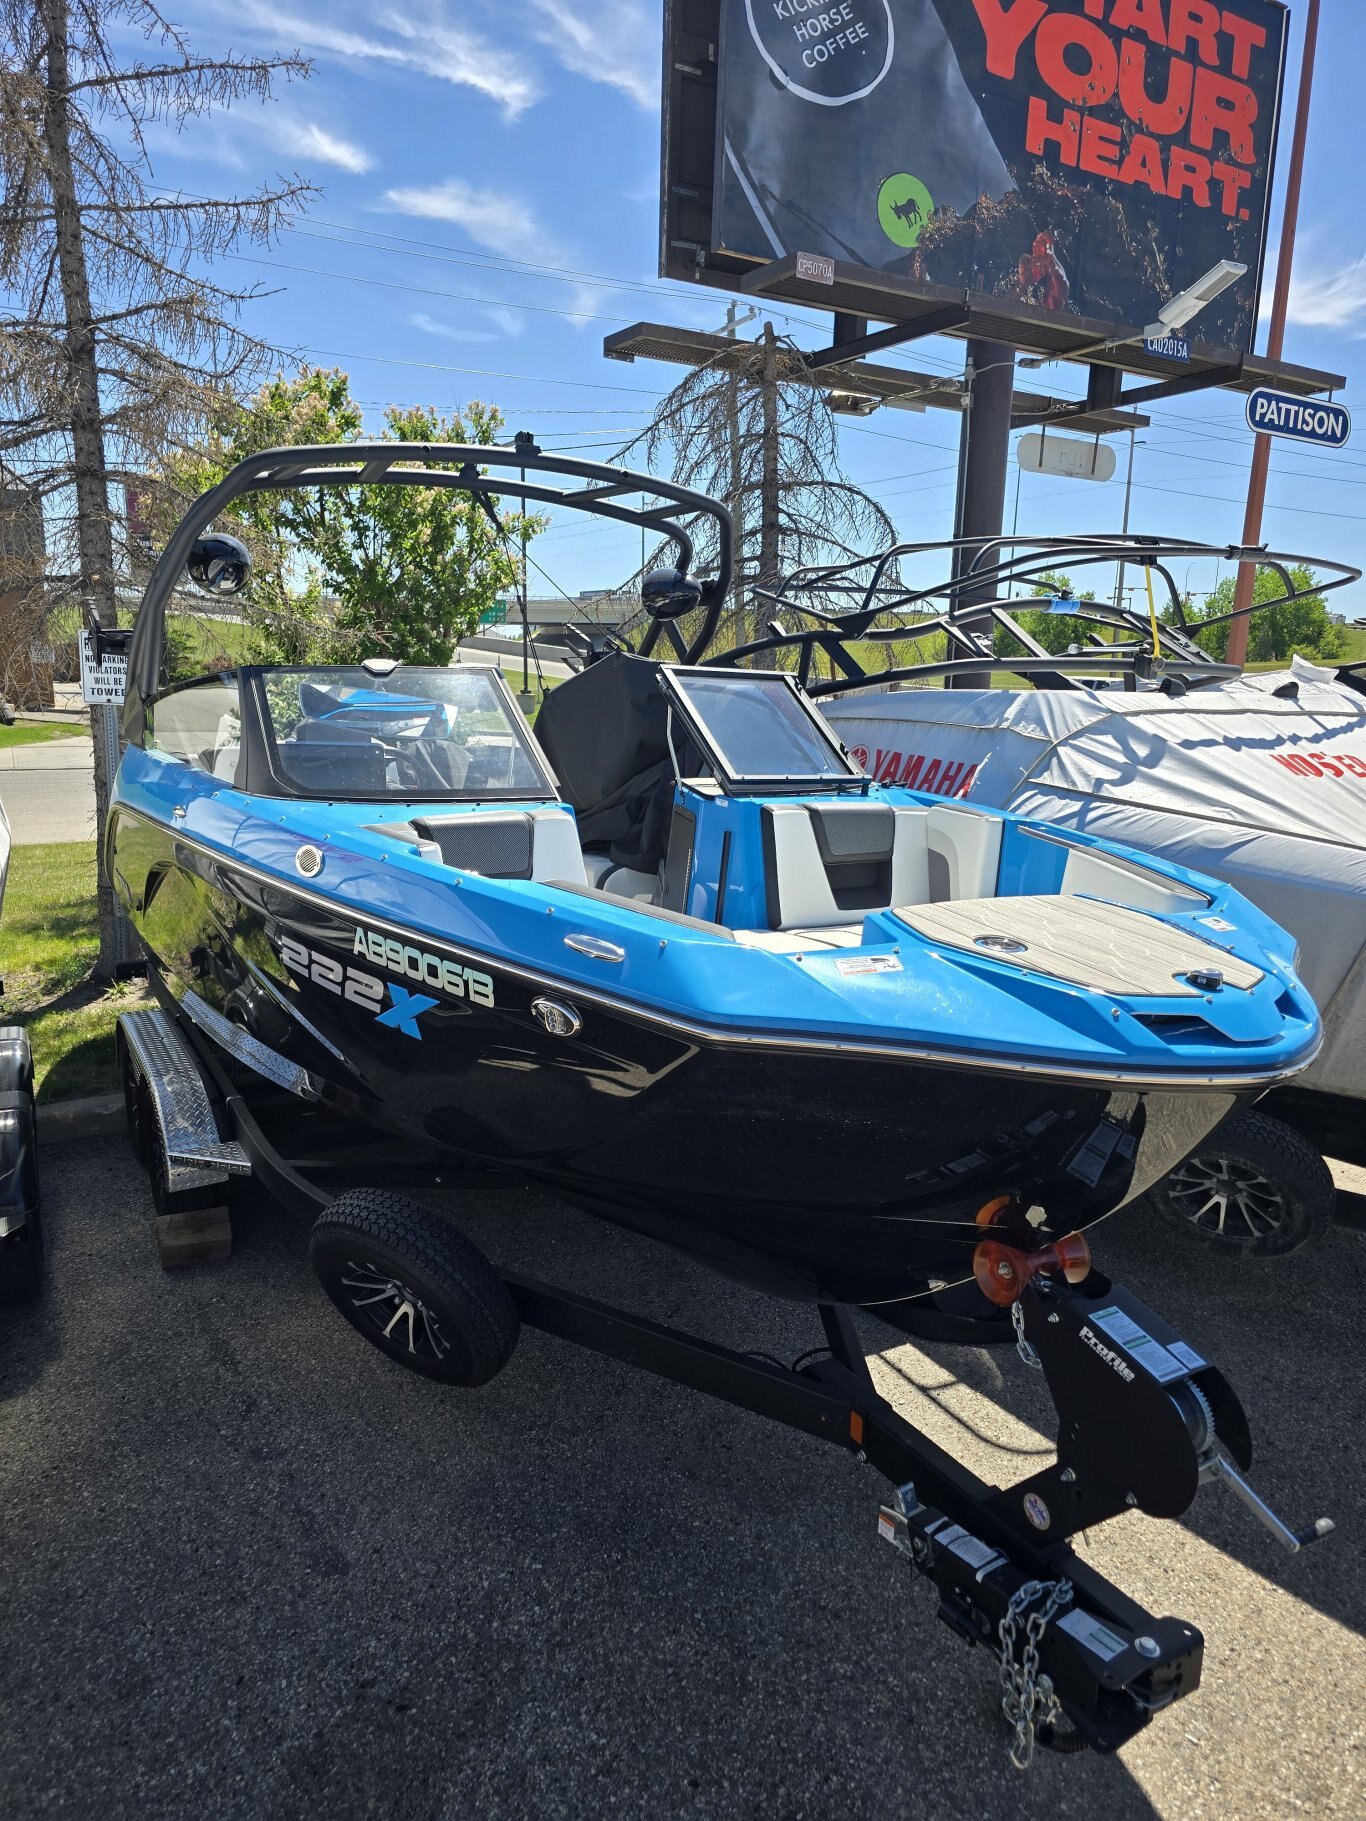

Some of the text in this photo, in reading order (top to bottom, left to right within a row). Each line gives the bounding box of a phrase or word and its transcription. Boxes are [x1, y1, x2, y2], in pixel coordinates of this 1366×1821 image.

[801, 22, 869, 68] COFFEE
[1083, 0, 1266, 80] ART
[971, 0, 1258, 164] YOUR
[1025, 95, 1251, 221] HEART.
[798, 258, 832, 278] CP5070A
[1255, 397, 1343, 438] PATTISON
[88, 666, 127, 676] VIOLATORS
[94, 677, 123, 686] WILL BE
[872, 748, 979, 798] YAMAHA
[1080, 1326, 1135, 1380] Profile
